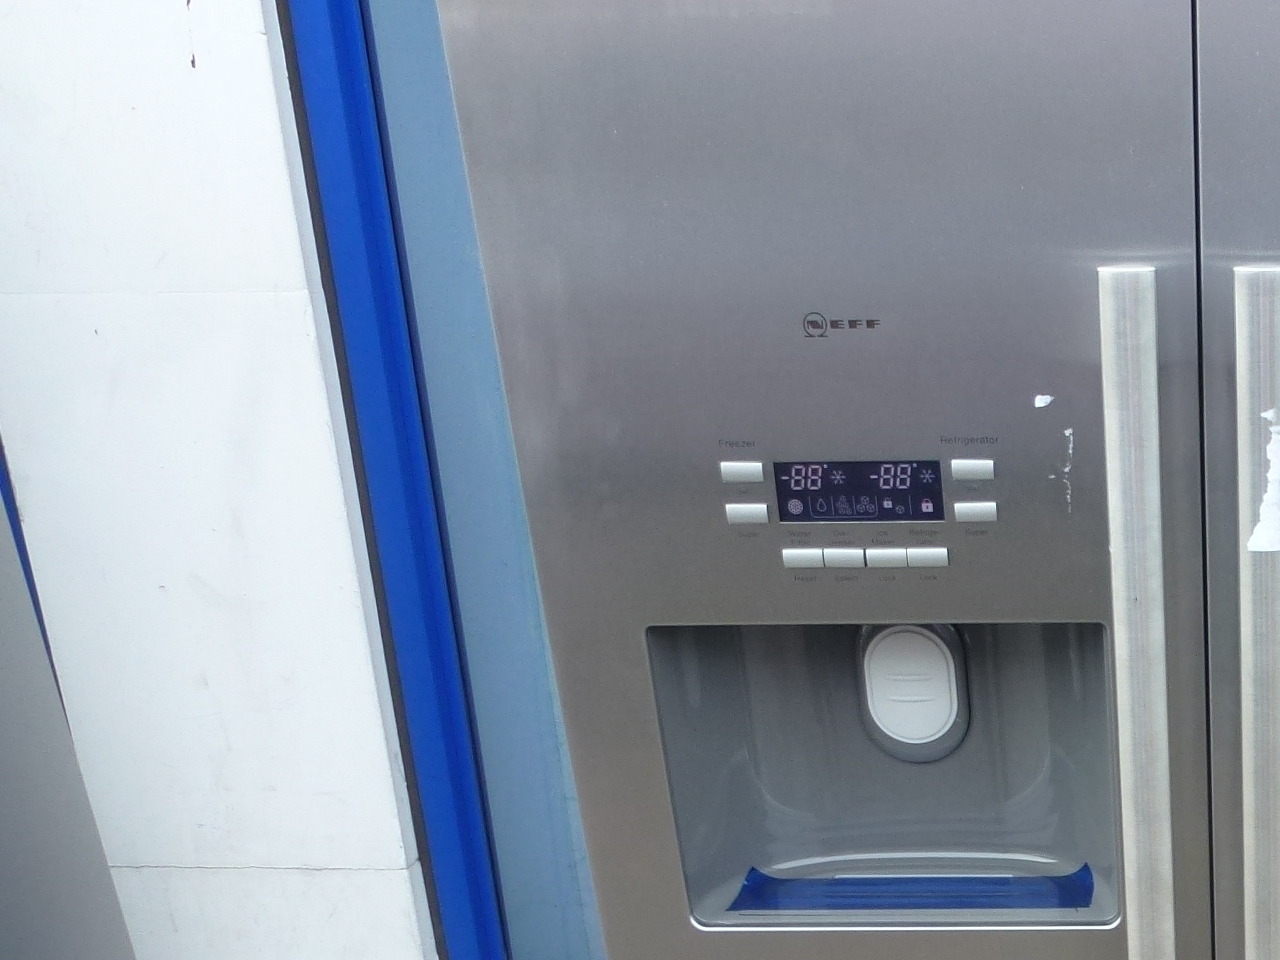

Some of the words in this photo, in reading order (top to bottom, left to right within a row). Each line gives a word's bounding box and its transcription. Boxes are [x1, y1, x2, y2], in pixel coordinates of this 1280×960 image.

[803, 312, 882, 338] NEFF
[718, 439, 756, 449] Freezer
[940, 435, 999, 446] Refrigerator
